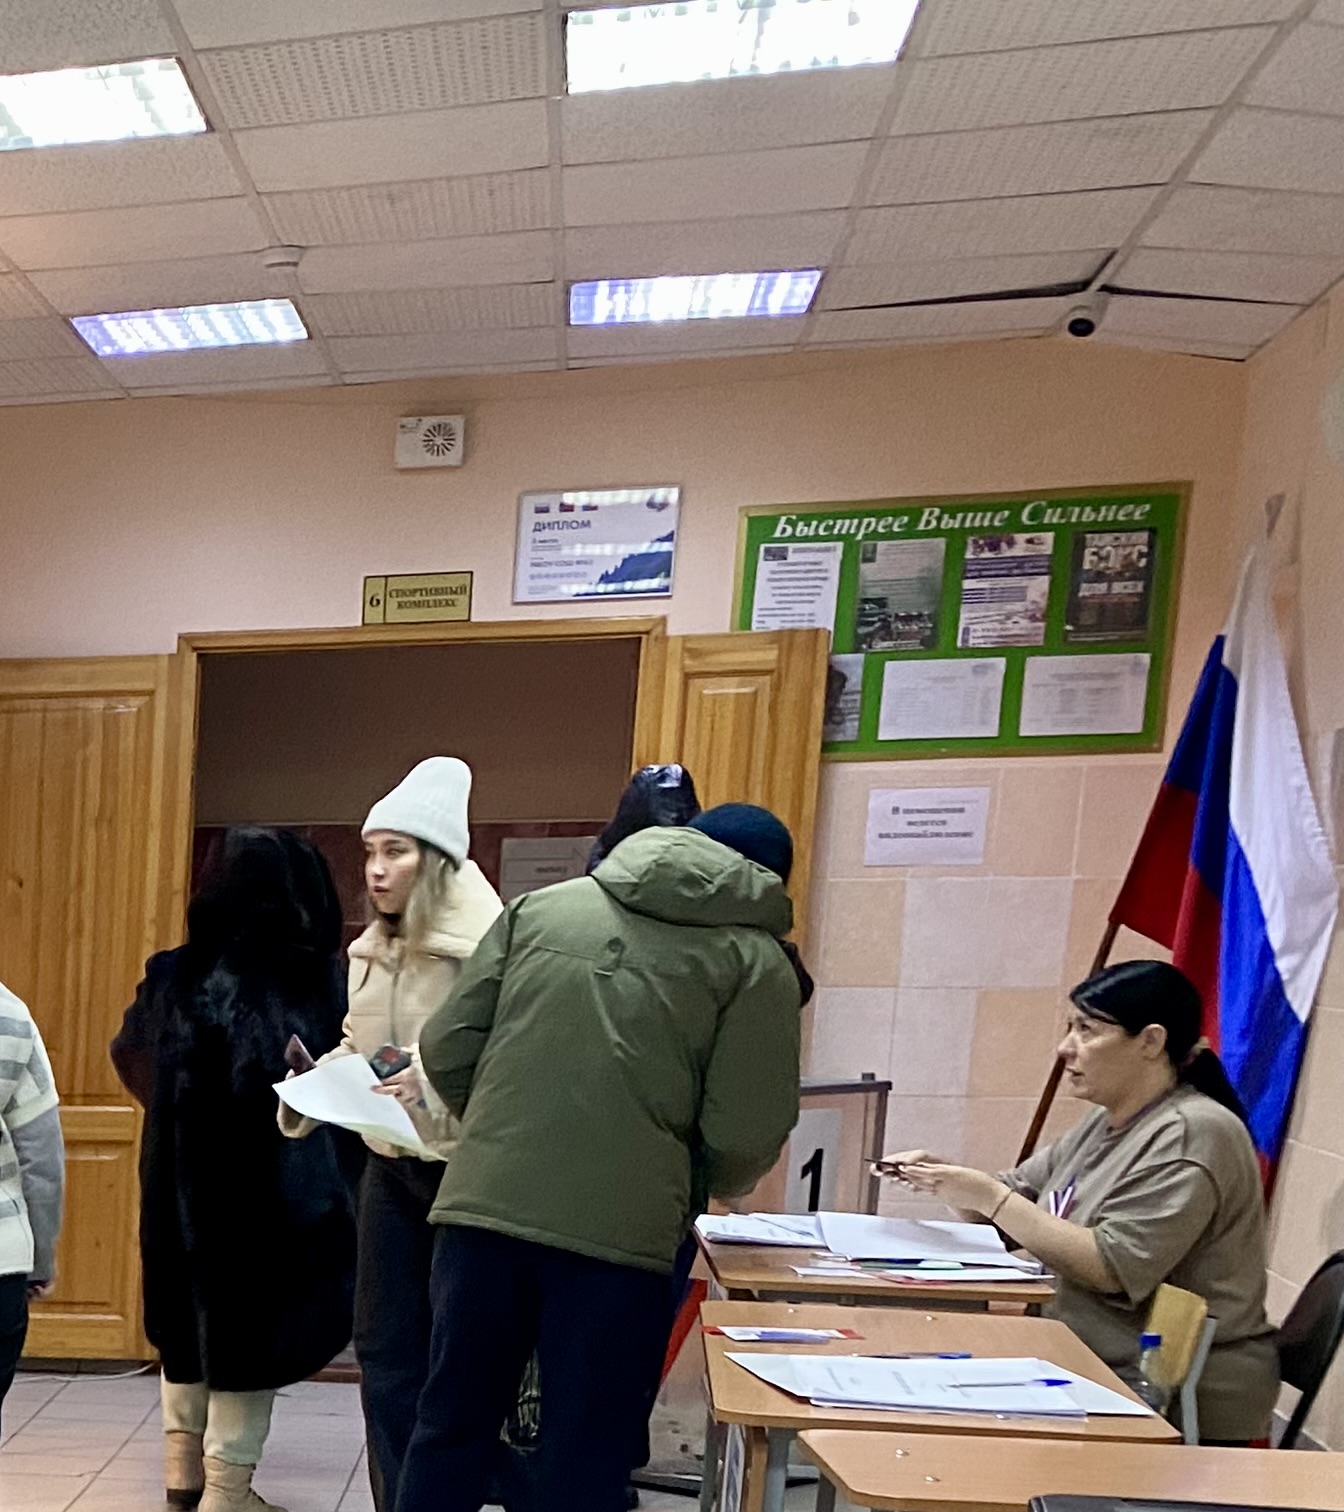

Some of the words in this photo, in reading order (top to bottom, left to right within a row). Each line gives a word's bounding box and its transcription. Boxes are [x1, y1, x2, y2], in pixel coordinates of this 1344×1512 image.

[532, 519, 591, 532] ДИПЛОМ
[772, 514, 909, 541] Быстрее
[916, 506, 1010, 532] Выше
[1020, 500, 1151, 526] Сильнее
[369, 592, 381, 607] 6
[389, 584, 467, 599] СПОРТИВНЫЙ
[396, 598, 457, 610] КОМПЛЕКС
[800, 1147, 824, 1213] 1
